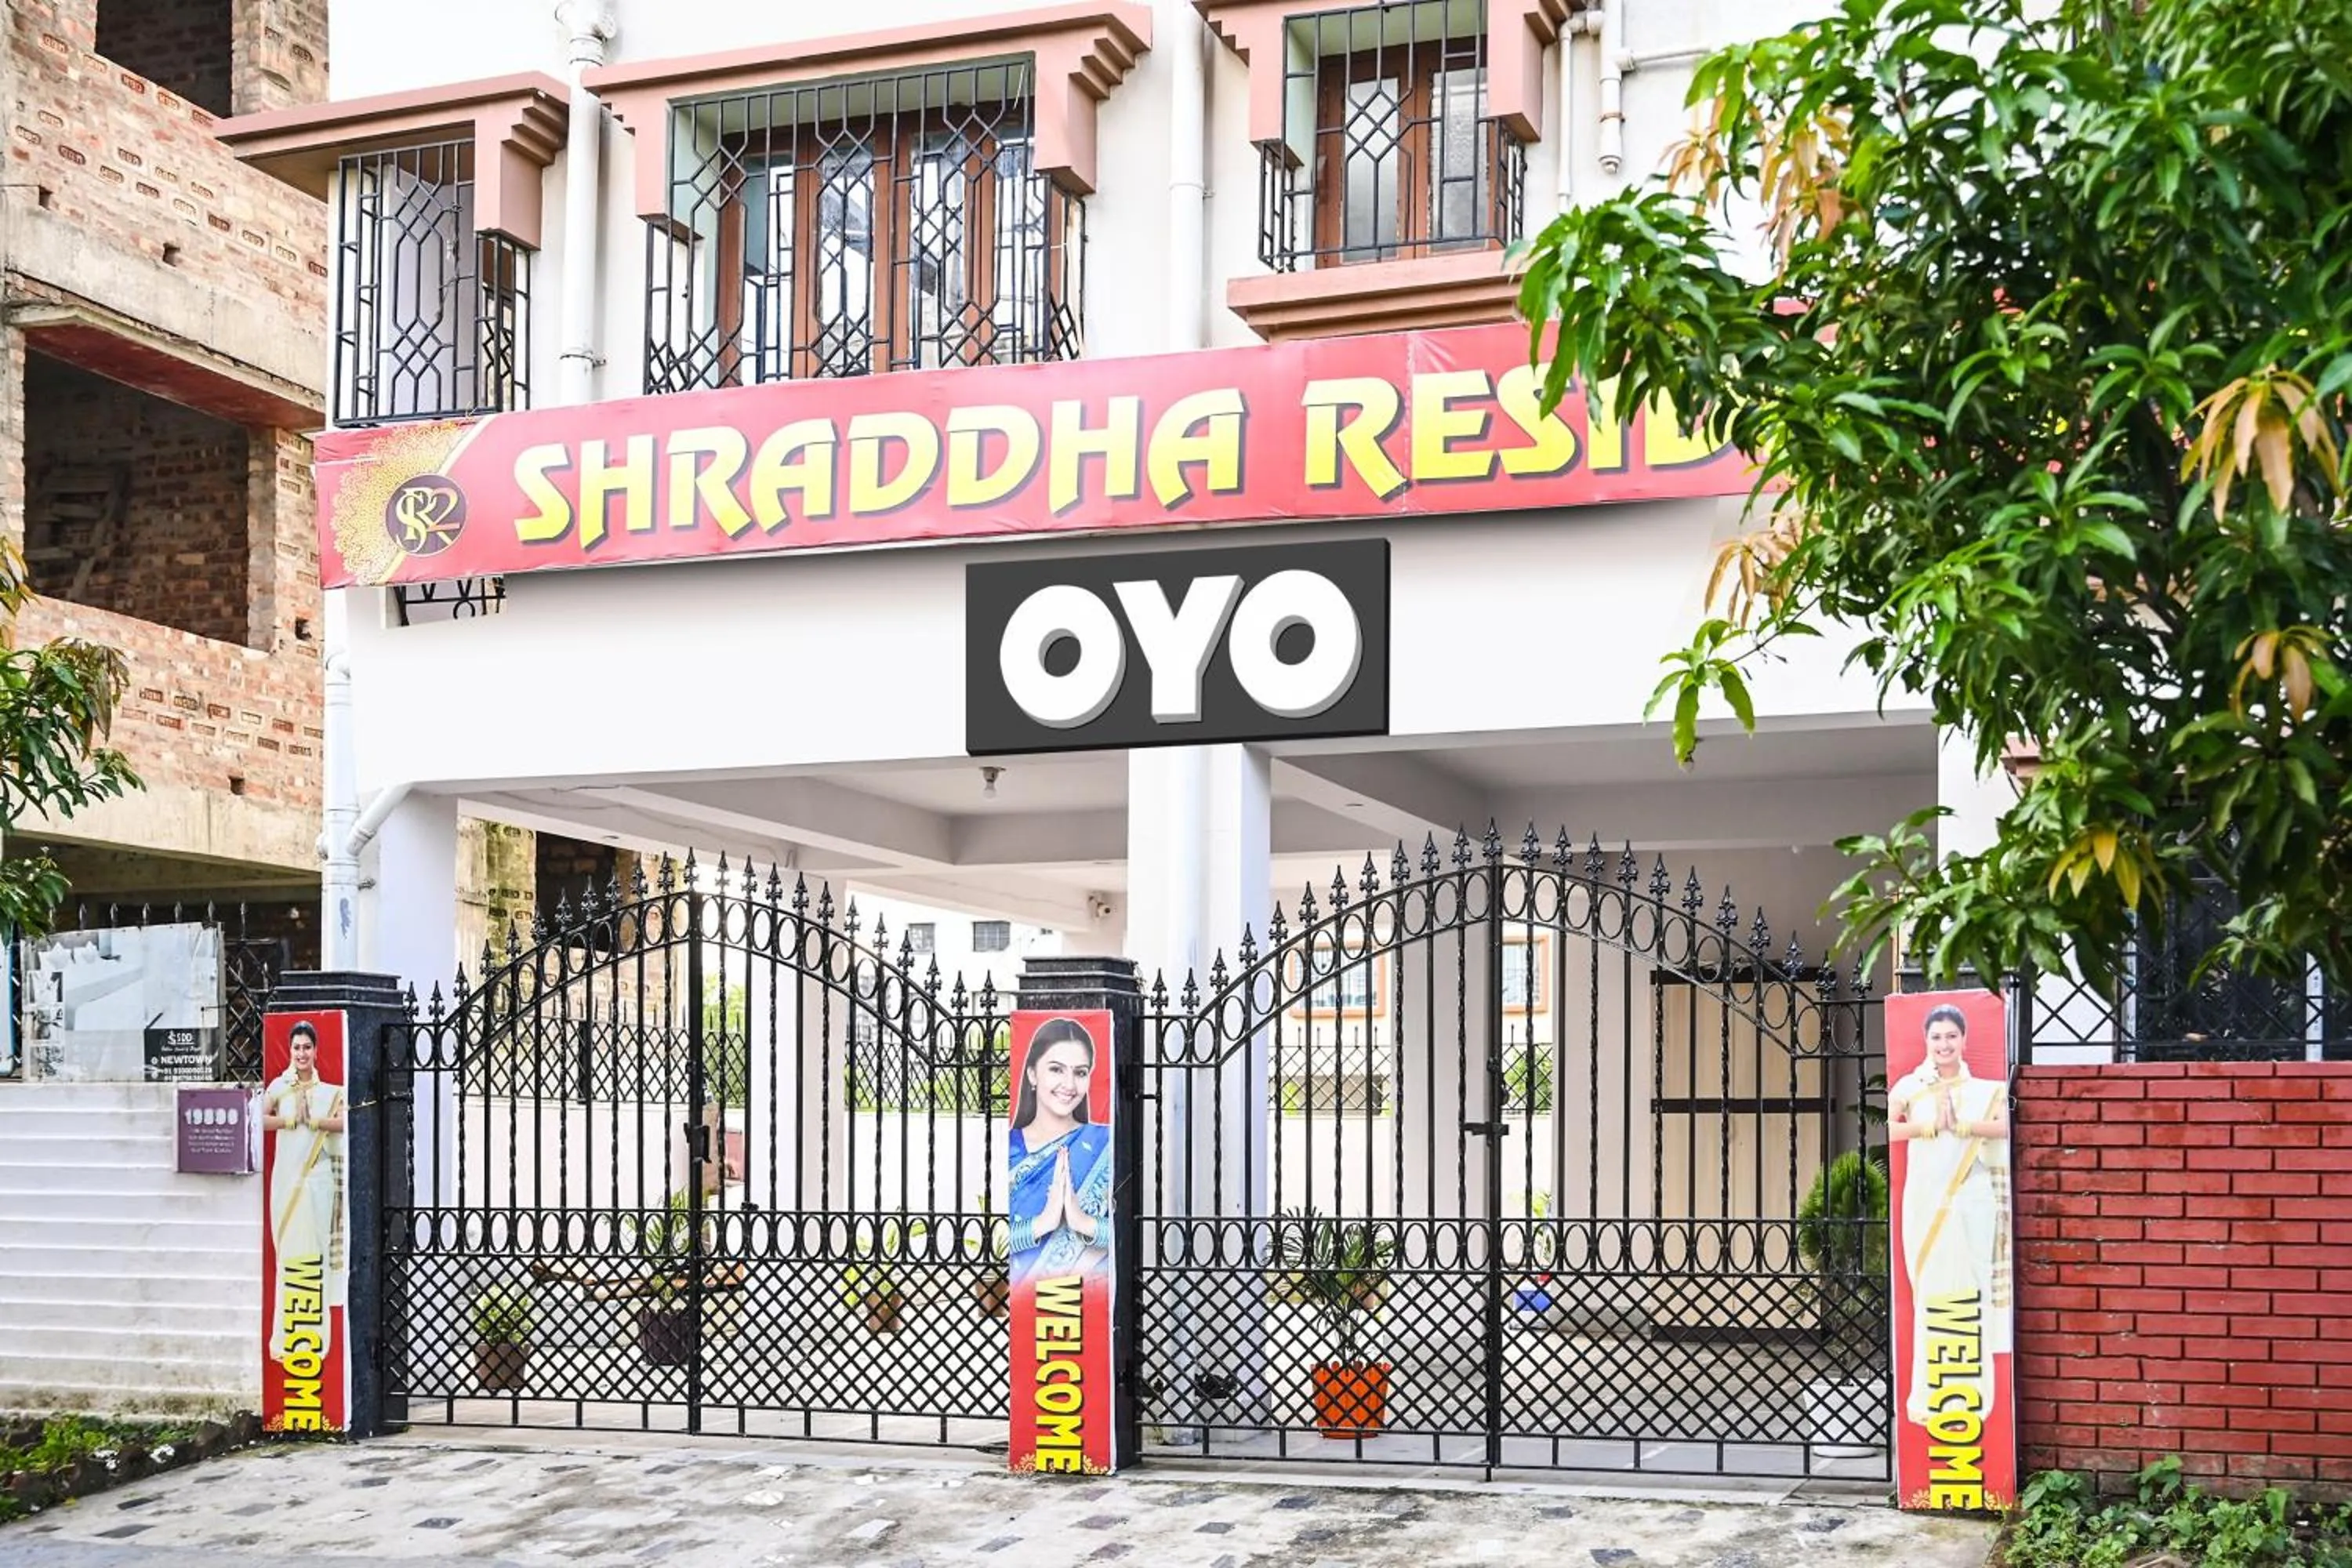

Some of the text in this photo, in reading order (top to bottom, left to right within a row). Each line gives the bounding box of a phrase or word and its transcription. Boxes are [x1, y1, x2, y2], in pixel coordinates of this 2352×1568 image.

[514, 359, 1756, 550] SHRADDHA RESID
[1000, 569, 1363, 729] OYO
[283, 1253, 324, 1432] WELCOME
[1034, 1274, 1084, 1474] WELCOME
[1926, 1289, 1984, 1510] WELCOME
